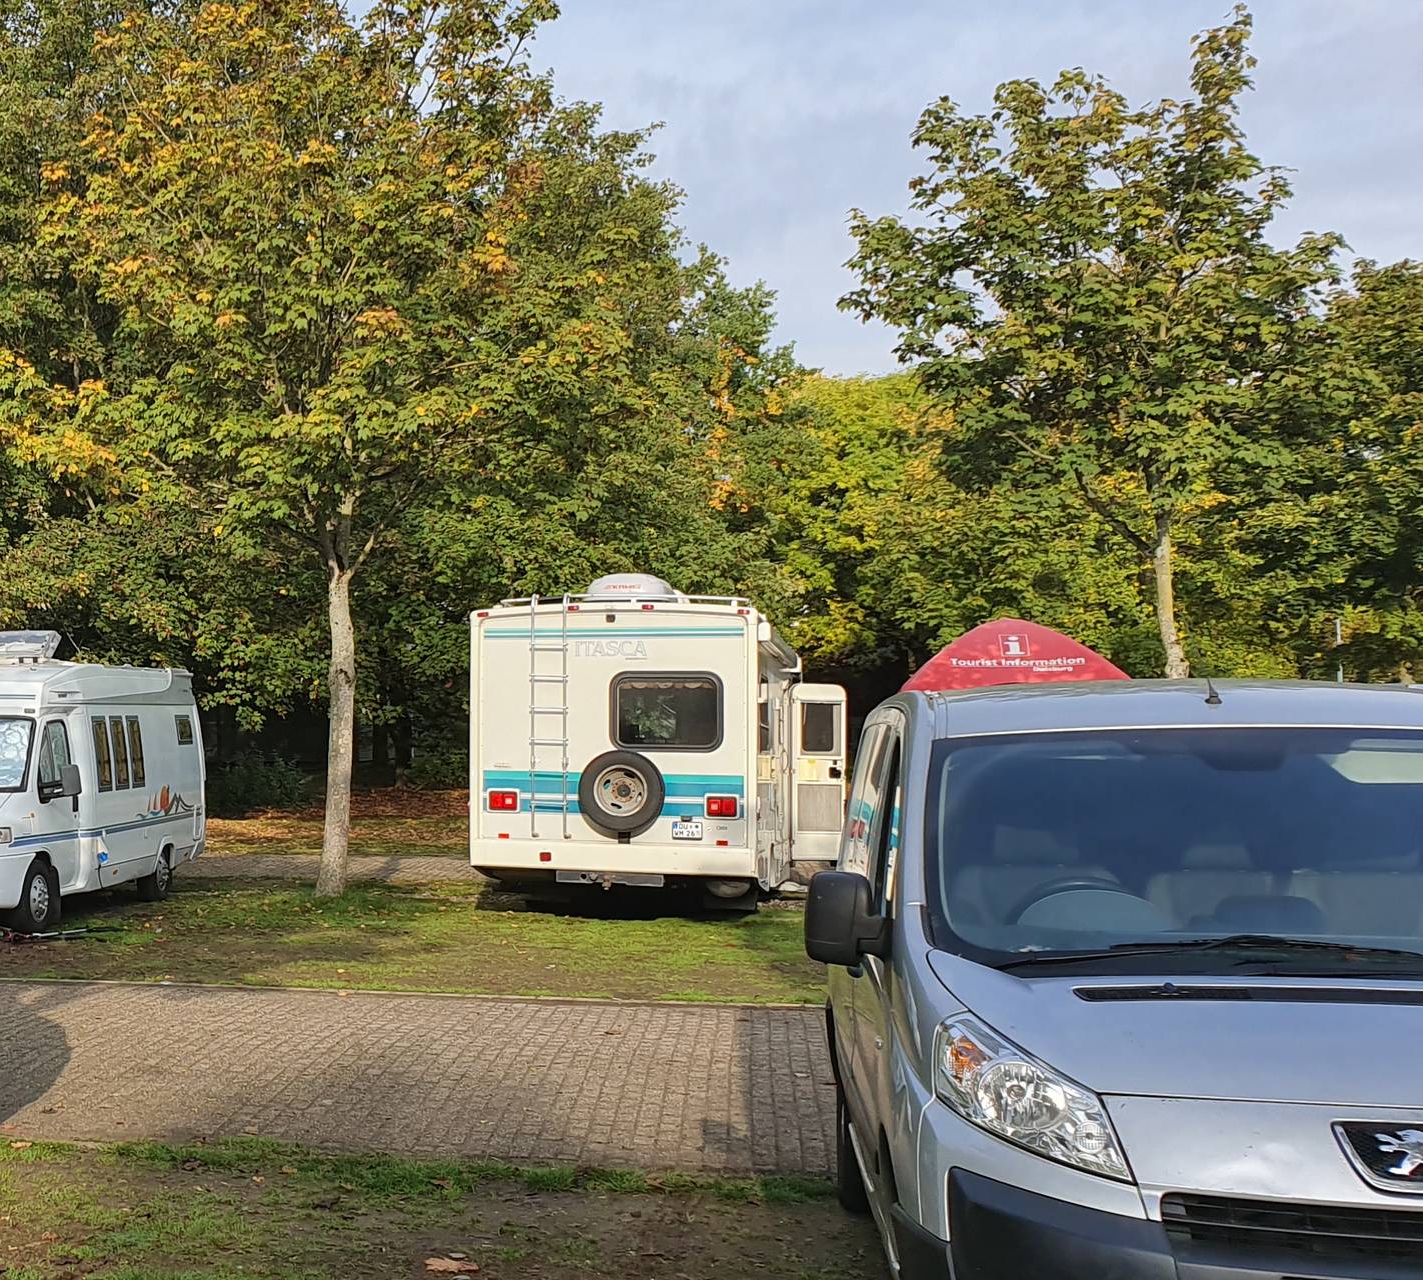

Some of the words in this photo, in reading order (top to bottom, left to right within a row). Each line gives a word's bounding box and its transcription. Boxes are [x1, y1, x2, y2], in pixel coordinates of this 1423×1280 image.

[575, 640, 647, 657] ITASCA
[950, 658, 997, 667] Tourist
[1001, 656, 1086, 667] Information
